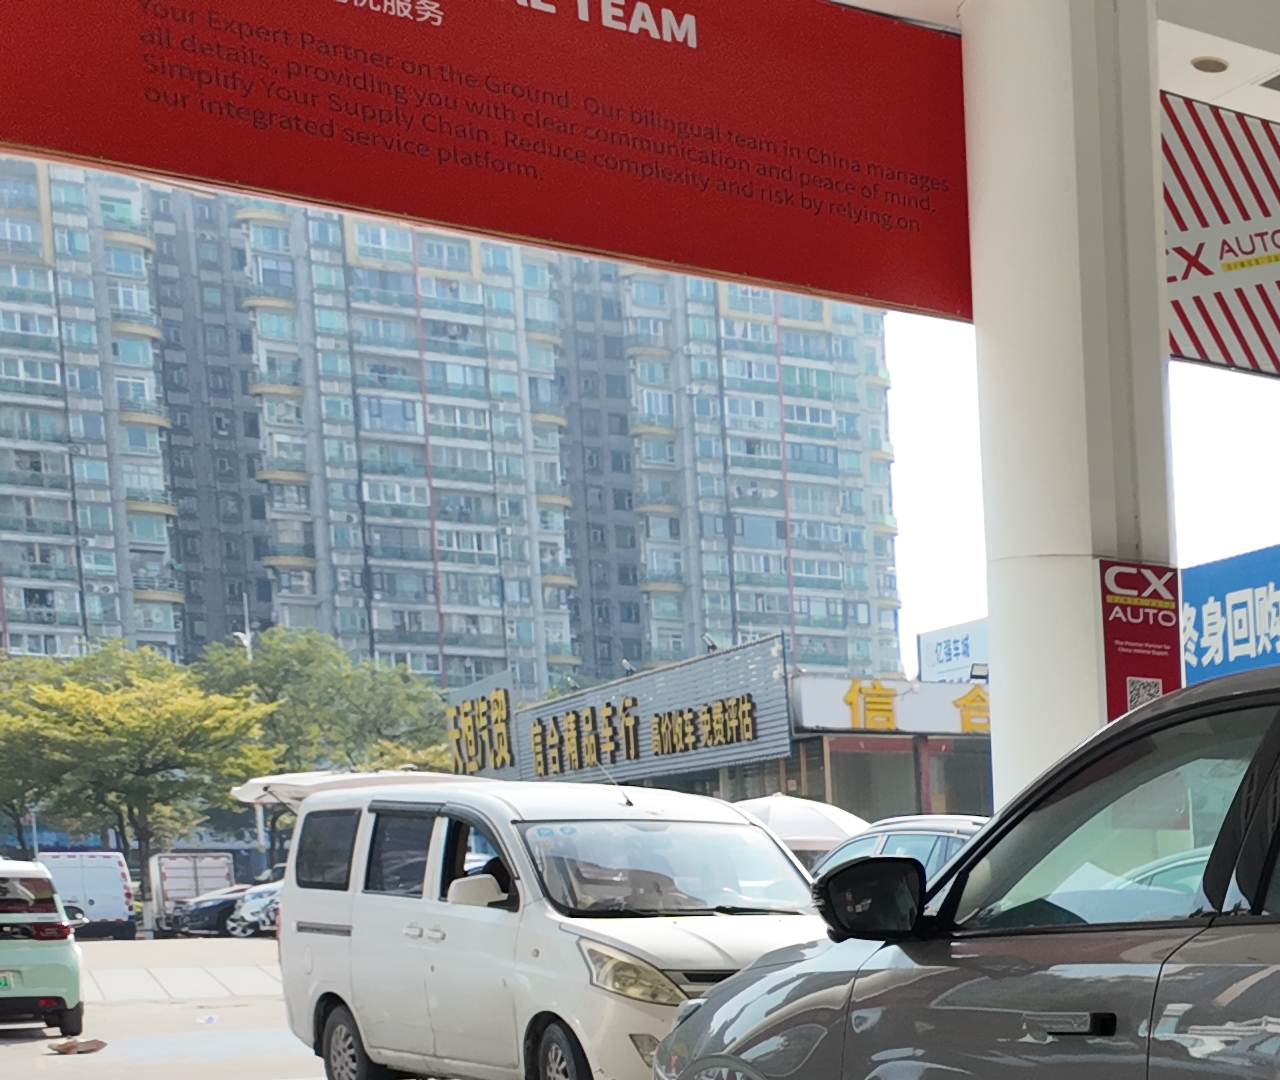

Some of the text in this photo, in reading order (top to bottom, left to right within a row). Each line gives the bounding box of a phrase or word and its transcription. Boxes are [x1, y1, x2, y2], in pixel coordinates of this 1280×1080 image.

[139, 1, 950, 193] Your Expert Partner on the Ground. Our bilingual team in China manages
[139, 29, 937, 213] all details, providing you with clear communication and peace of mind.
[143, 86, 545, 181] our integrated service platform.
[143, 53, 921, 233] Simplify Your Supply Chain. Reduce complexity and risk by relying on
[1166, 241, 1215, 284] X
[1104, 565, 1175, 600] CX
[1108, 605, 1177, 627] AUTO
[531, 692, 757, 776] 信合精品车行 高价收车 免费评估
